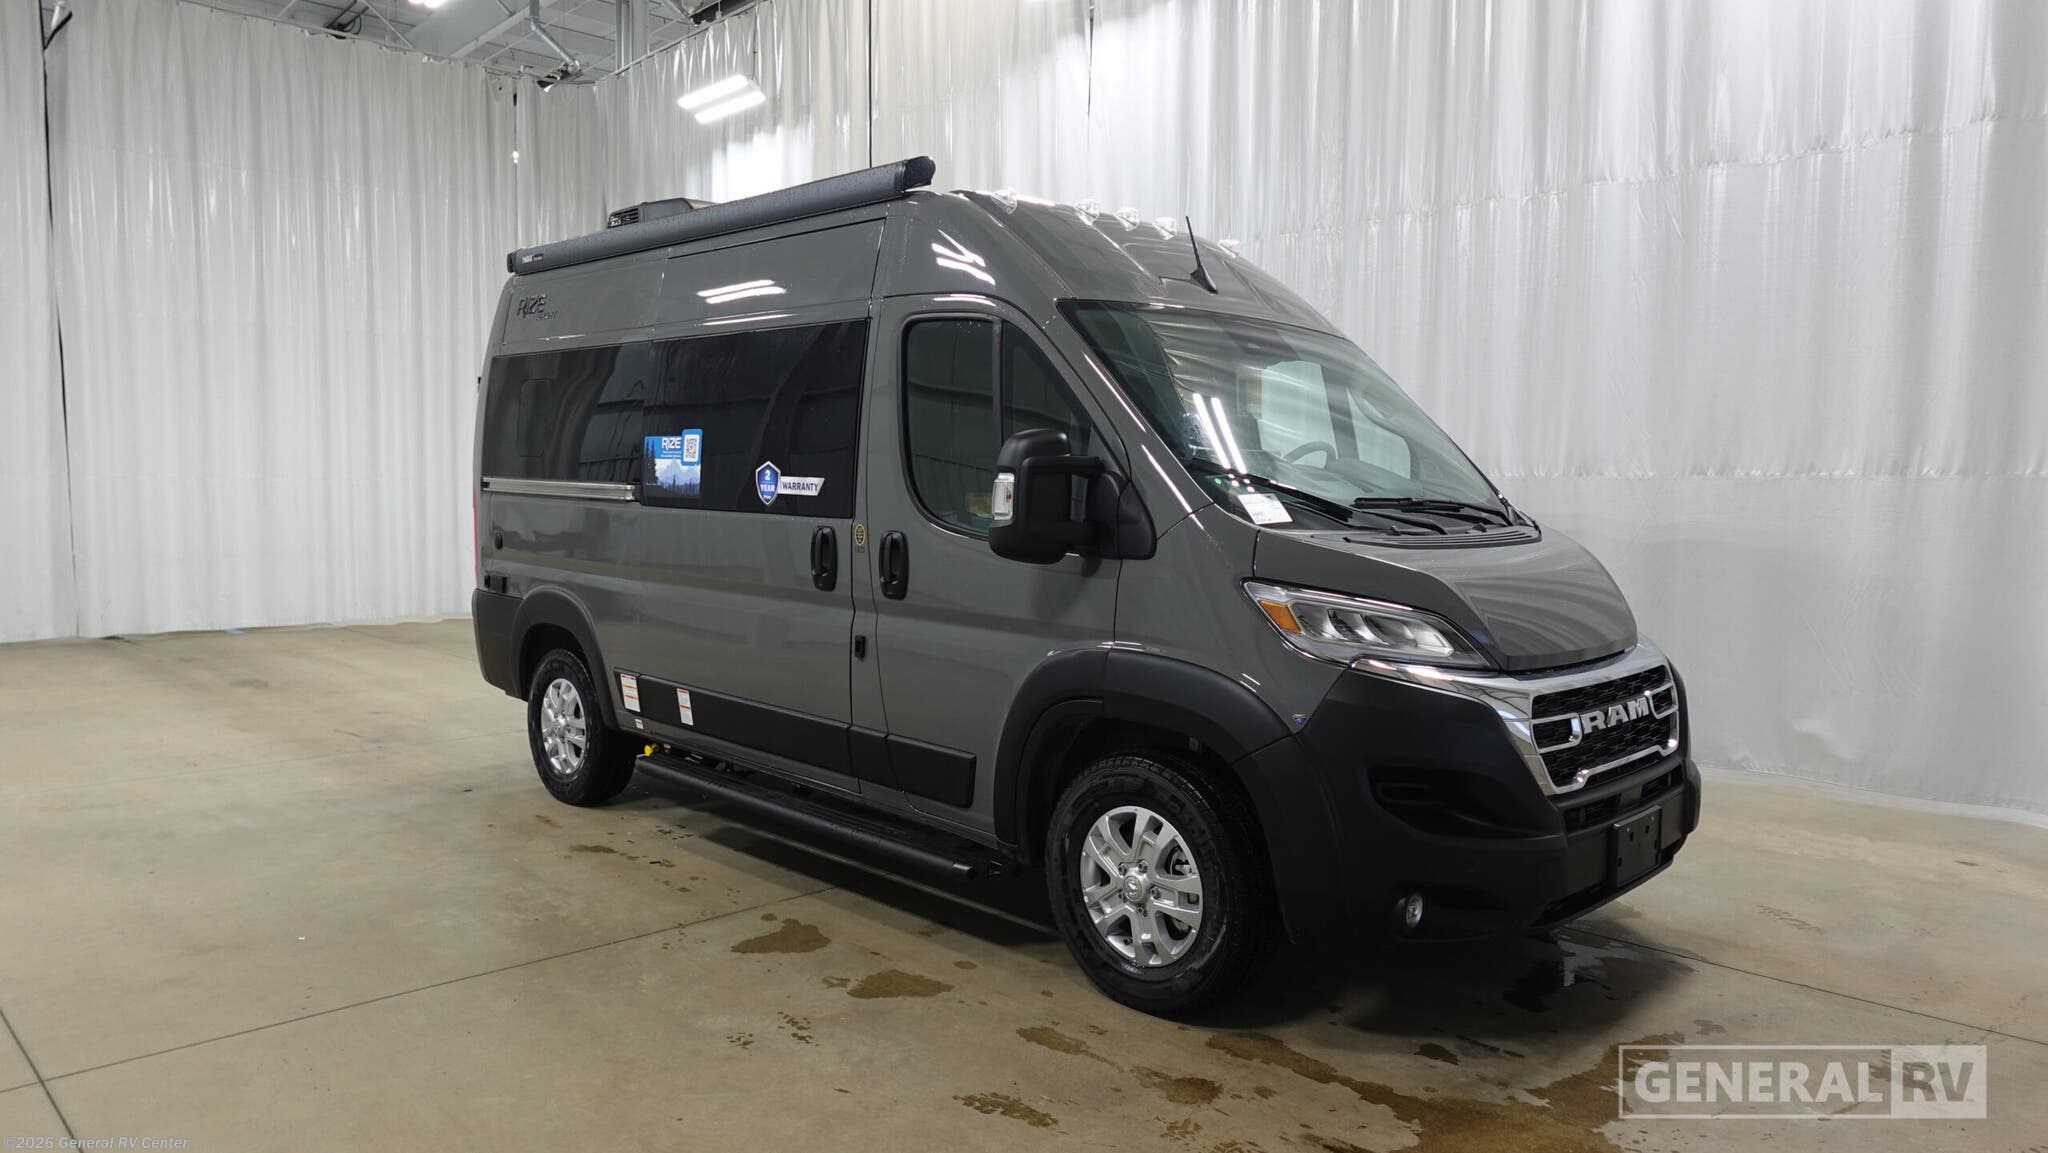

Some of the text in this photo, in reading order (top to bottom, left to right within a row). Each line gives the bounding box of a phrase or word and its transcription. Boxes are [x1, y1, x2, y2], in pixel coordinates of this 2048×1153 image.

[517, 294, 547, 319] RIZE
[661, 437, 681, 450] RIZE
[765, 469, 771, 480] 2
[760, 484, 776, 492] YEAR
[782, 482, 819, 491] WARRANTY
[1580, 696, 1650, 735] RAM
